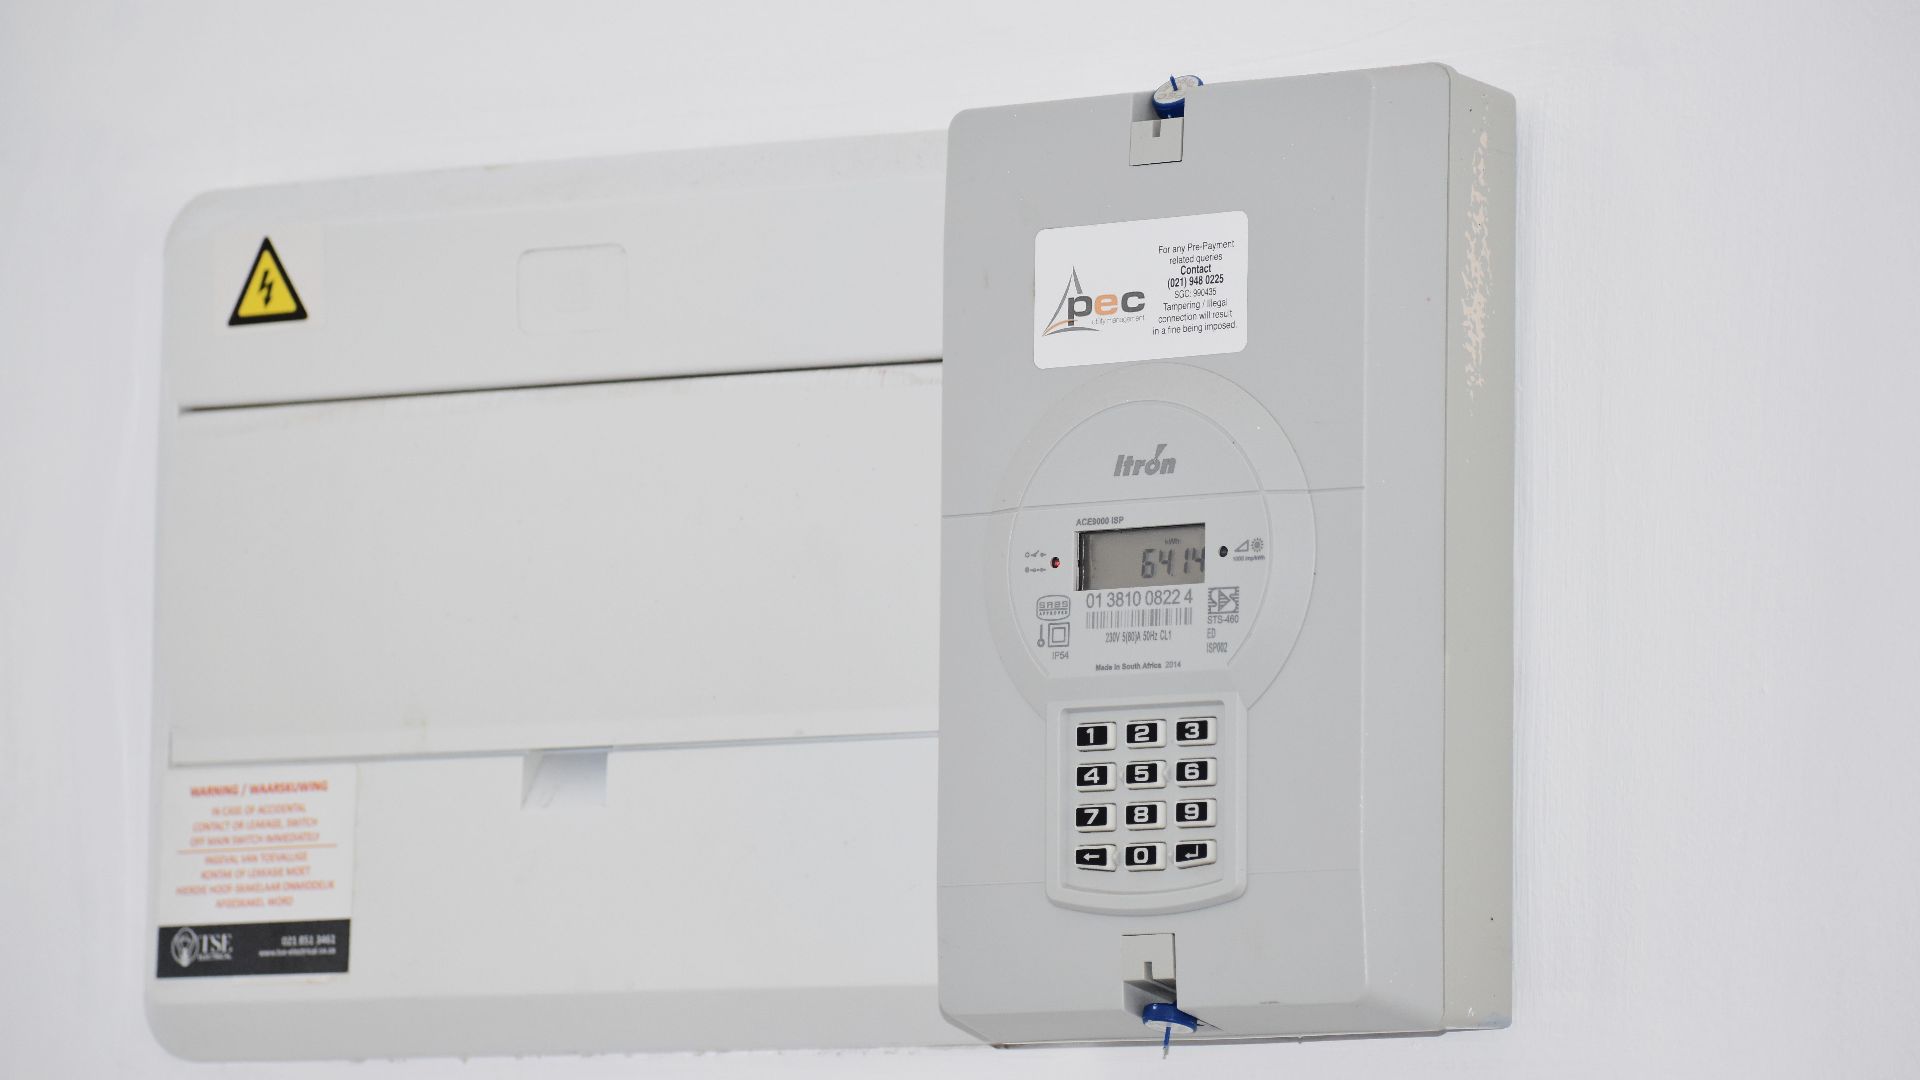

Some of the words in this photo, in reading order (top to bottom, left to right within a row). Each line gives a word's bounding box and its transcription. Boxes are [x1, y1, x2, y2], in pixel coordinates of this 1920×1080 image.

[1158, 245, 1170, 254] For
[1172, 246, 1185, 255] any
[1188, 240, 1234, 252] Pre-Payment
[1170, 254, 1194, 264] related
[1196, 253, 1222, 264] queries
[1180, 264, 1211, 275] Contact
[1167, 277, 1187, 290] (021)
[1189, 276, 1203, 286] 948
[1205, 273, 1224, 284] 0225
[1163, 301, 1200, 312] Tampering
[1206, 298, 1228, 308] Illegal
[1158, 313, 1197, 324] connection
[1199, 310, 1211, 320] will
[1212, 310, 1233, 319] result
[1152, 326, 1159, 335] in
[1168, 325, 1181, 334] fine
[1182, 324, 1203, 334] being
[1113, 443, 1177, 477] Itron
[1076, 517, 1110, 526] ACE9000
[1111, 516, 1124, 524] ISP
[1086, 593, 1102, 608] 01
[1106, 591, 1142, 607] 3810
[1145, 589, 1181, 606] 0822
[1184, 588, 1193, 604] 4
[1207, 614, 1239, 624] STS-460
[1105, 632, 1120, 643] 230V
[1143, 630, 1158, 641] 50Hz
[1160, 630, 1172, 641] CL1
[1207, 627, 1216, 639] ED
[1052, 651, 1069, 660] IP54
[1122, 662, 1140, 670] South
[1142, 661, 1162, 669] Africa
[1165, 661, 1181, 669] 2014
[1086, 728, 1094, 744] 1
[1134, 725, 1149, 742] 2
[1185, 722, 1199, 739] 3
[1083, 768, 1100, 784] 4
[1135, 766, 1149, 781] 5
[1185, 763, 1199, 780] 6
[190, 784, 240, 797] WARNING
[250, 780, 329, 794] WAARSKUWING
[222, 806, 242, 816] CASE
[244, 805, 255, 815] OF
[258, 803, 306, 814] ACCIDENTAL
[1084, 809, 1099, 825] 7
[1134, 806, 1149, 823] 8
[1185, 804, 1199, 820] 9
[192, 821, 230, 832] CONTACT
[232, 821, 244, 830] OR
[286, 817, 318, 828] SWITCH
[207, 836, 230, 846] MAIN
[232, 834, 263, 845] SWITCH
[265, 832, 320, 843] IMMEDIATELY
[1134, 848, 1149, 864] 0
[286, 865, 310, 876] MOET
[267, 896, 294, 907] WORD
